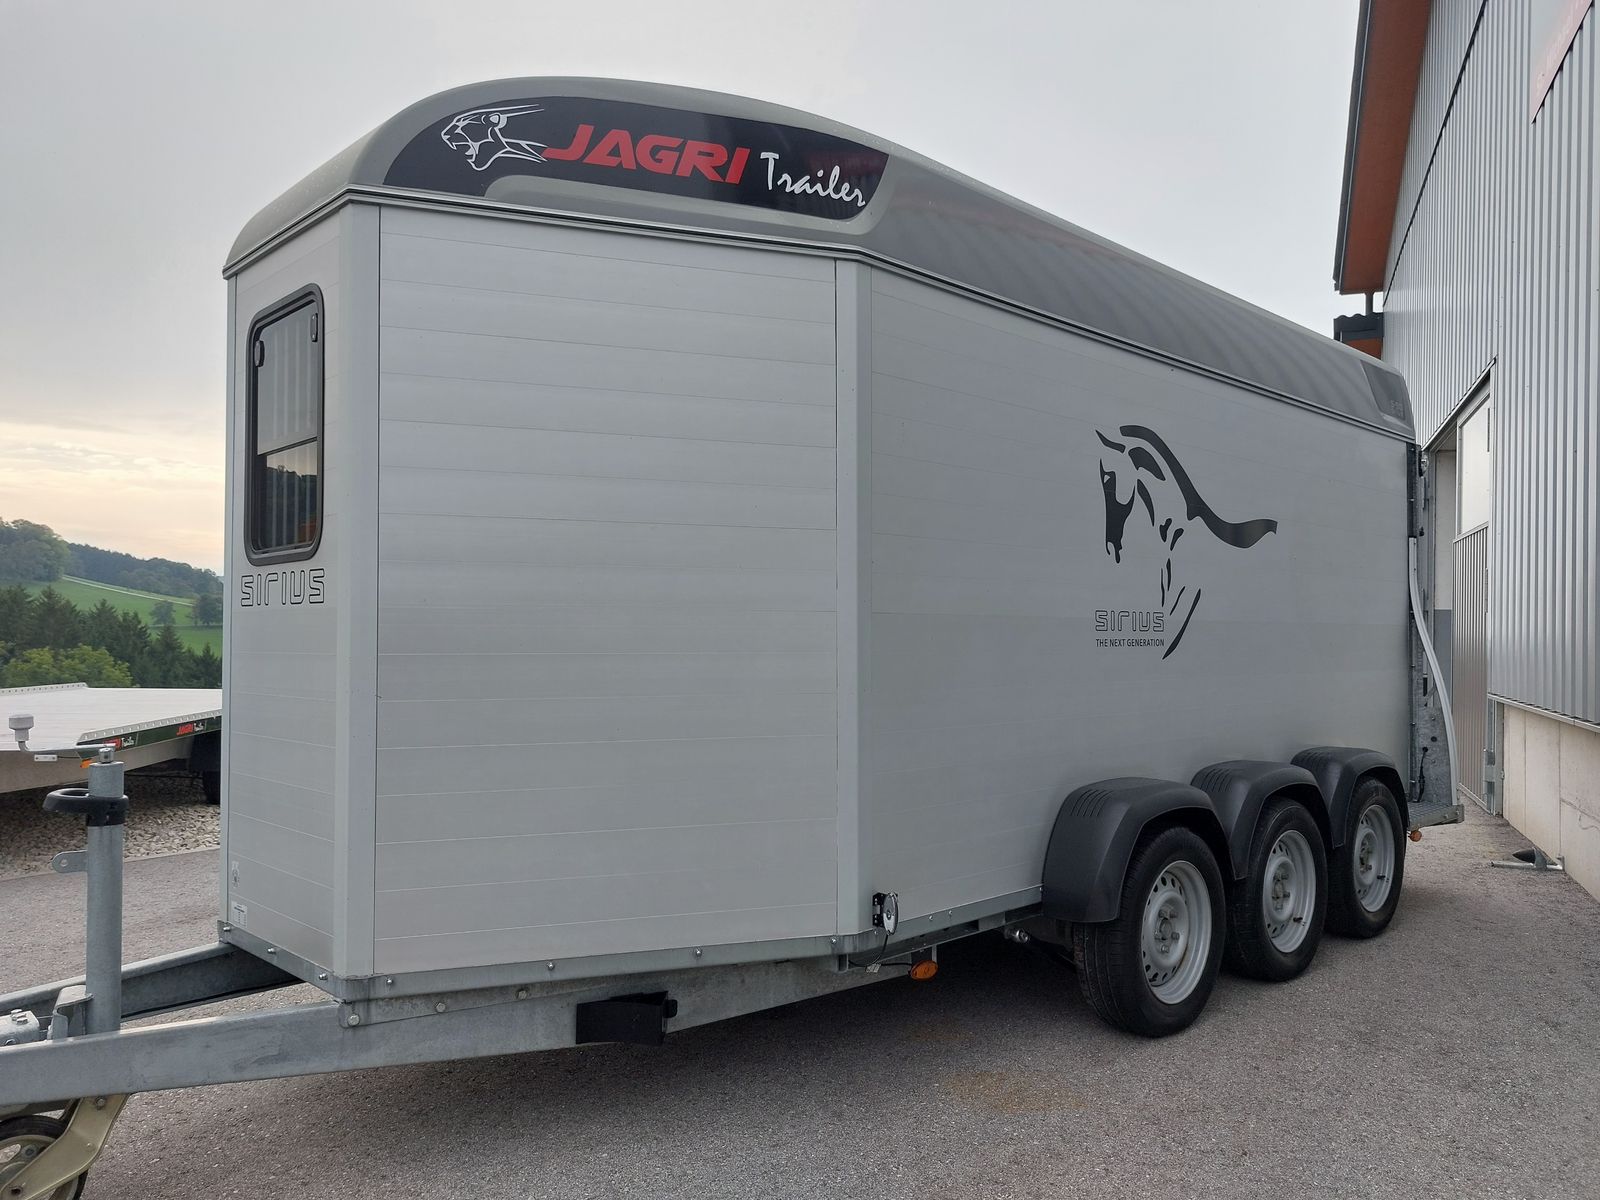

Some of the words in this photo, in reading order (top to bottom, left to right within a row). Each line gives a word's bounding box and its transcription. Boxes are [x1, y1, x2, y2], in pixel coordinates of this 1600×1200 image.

[541, 124, 751, 185] JAGRI
[760, 151, 866, 207] Trailer
[1095, 639, 1108, 648] THE
[1109, 639, 1126, 648] NEXT
[1127, 638, 1165, 648] GENERATION
